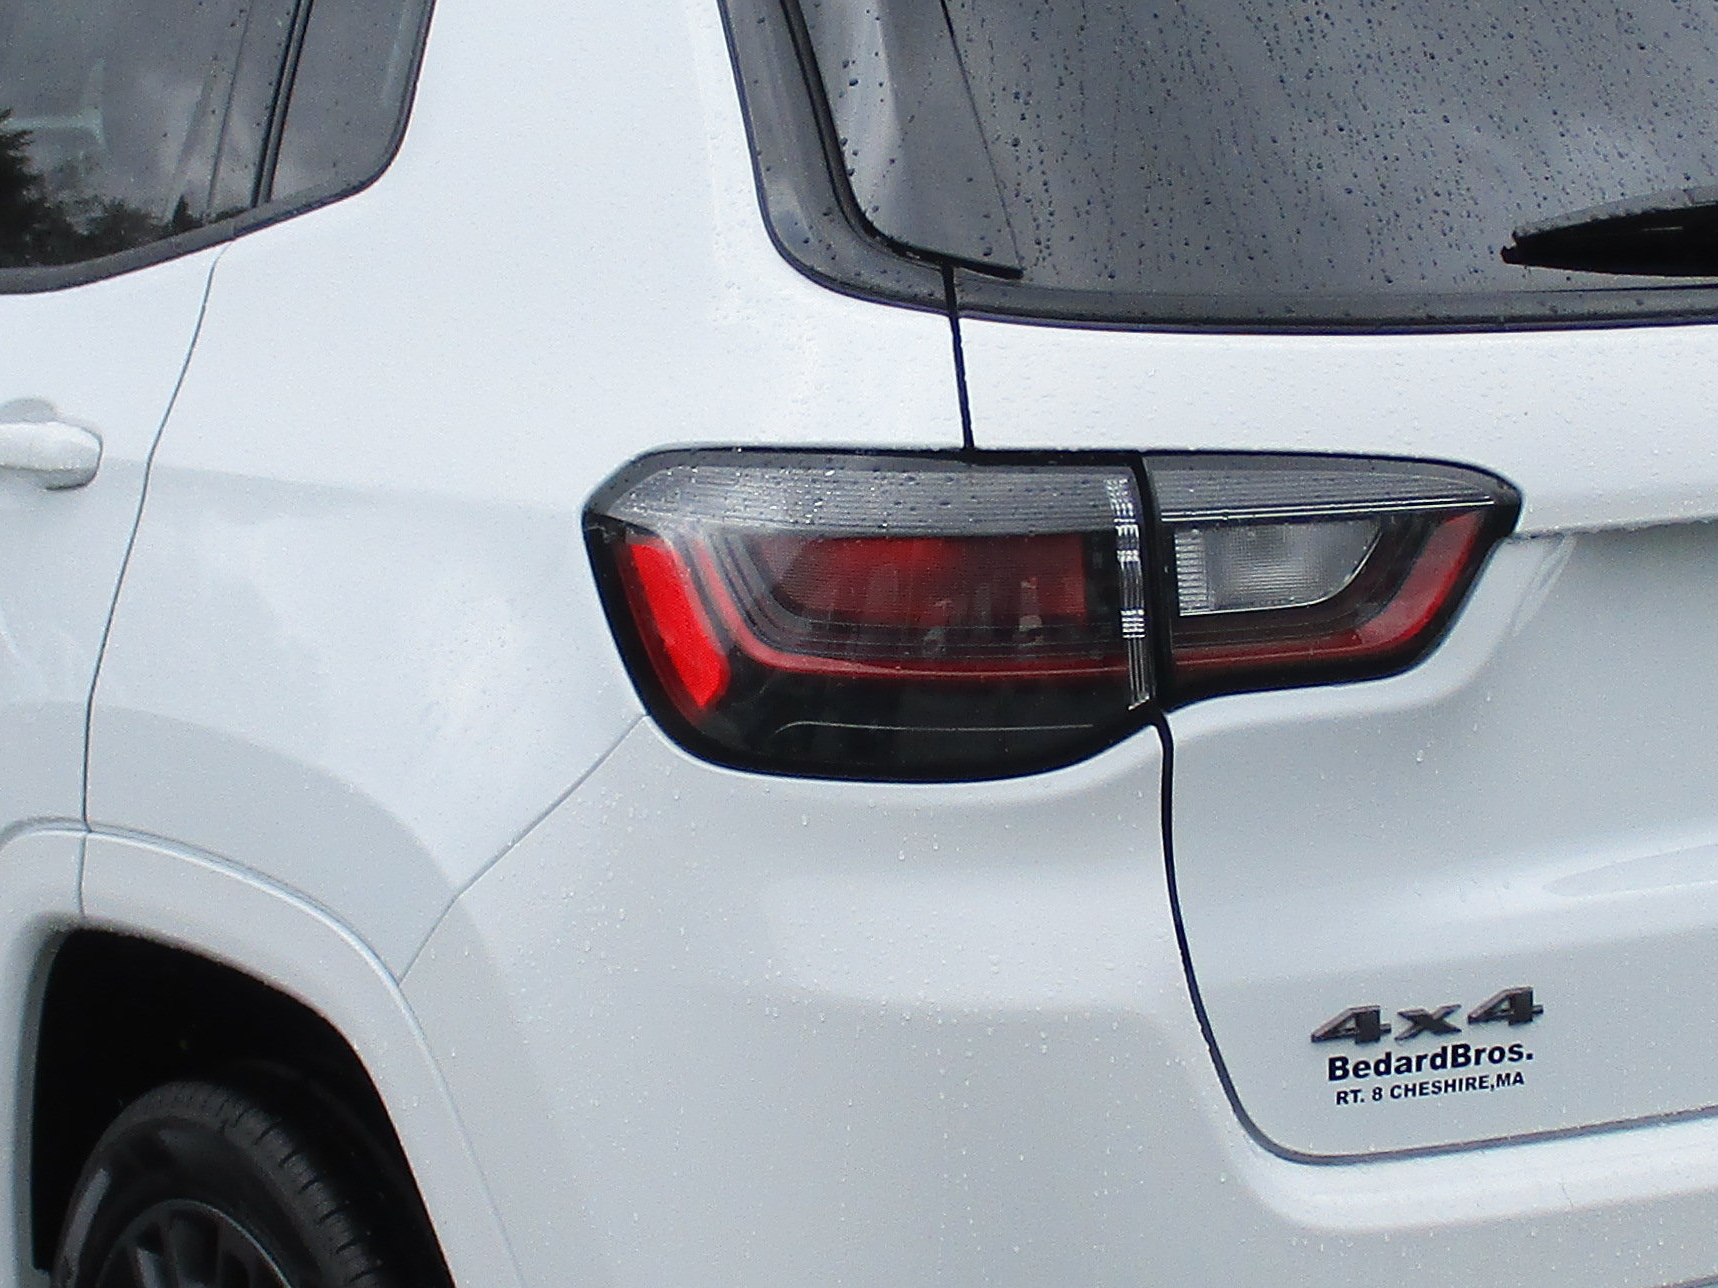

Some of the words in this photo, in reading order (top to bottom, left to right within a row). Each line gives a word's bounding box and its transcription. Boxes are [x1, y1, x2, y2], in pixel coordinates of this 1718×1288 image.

[1311, 986, 1544, 1045] 4x4
[1336, 1088, 1365, 1105] RT.
[1371, 1086, 1383, 1102] 8
